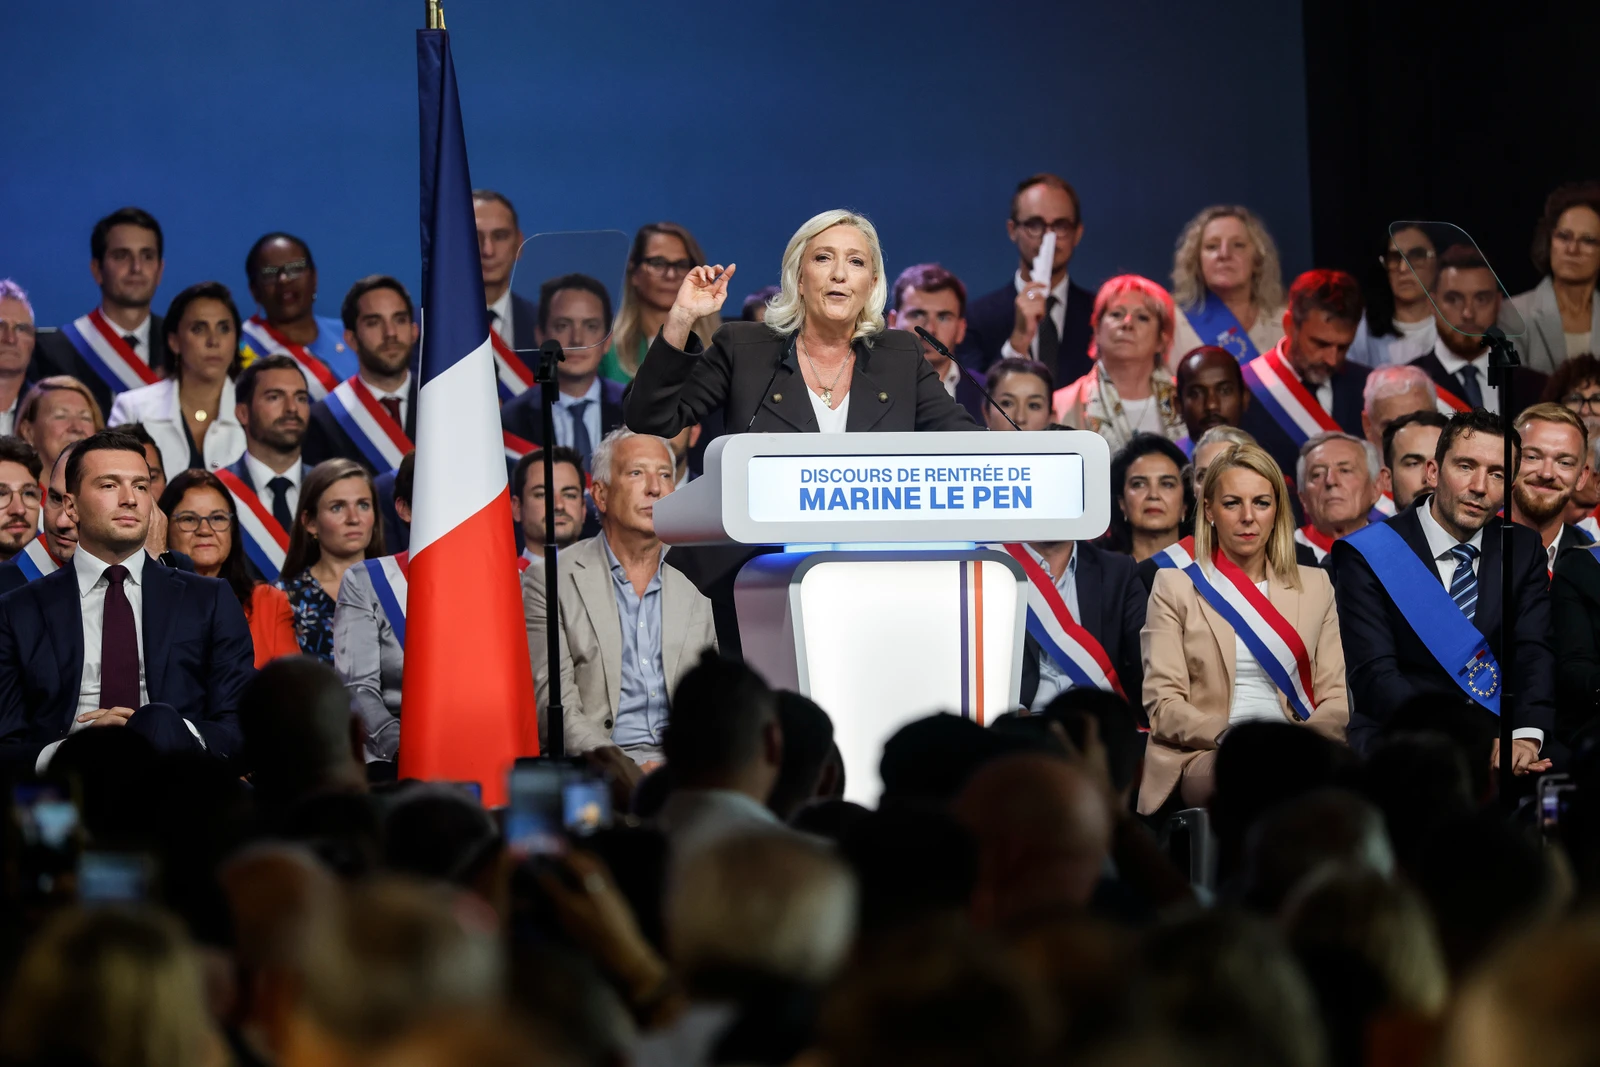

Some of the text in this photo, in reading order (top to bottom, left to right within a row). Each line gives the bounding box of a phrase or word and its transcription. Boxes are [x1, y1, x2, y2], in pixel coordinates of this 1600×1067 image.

[800, 464, 1031, 483] DISCOURS DE RENTRÉE DE
[799, 486, 1033, 511] MARINE LE PEN
